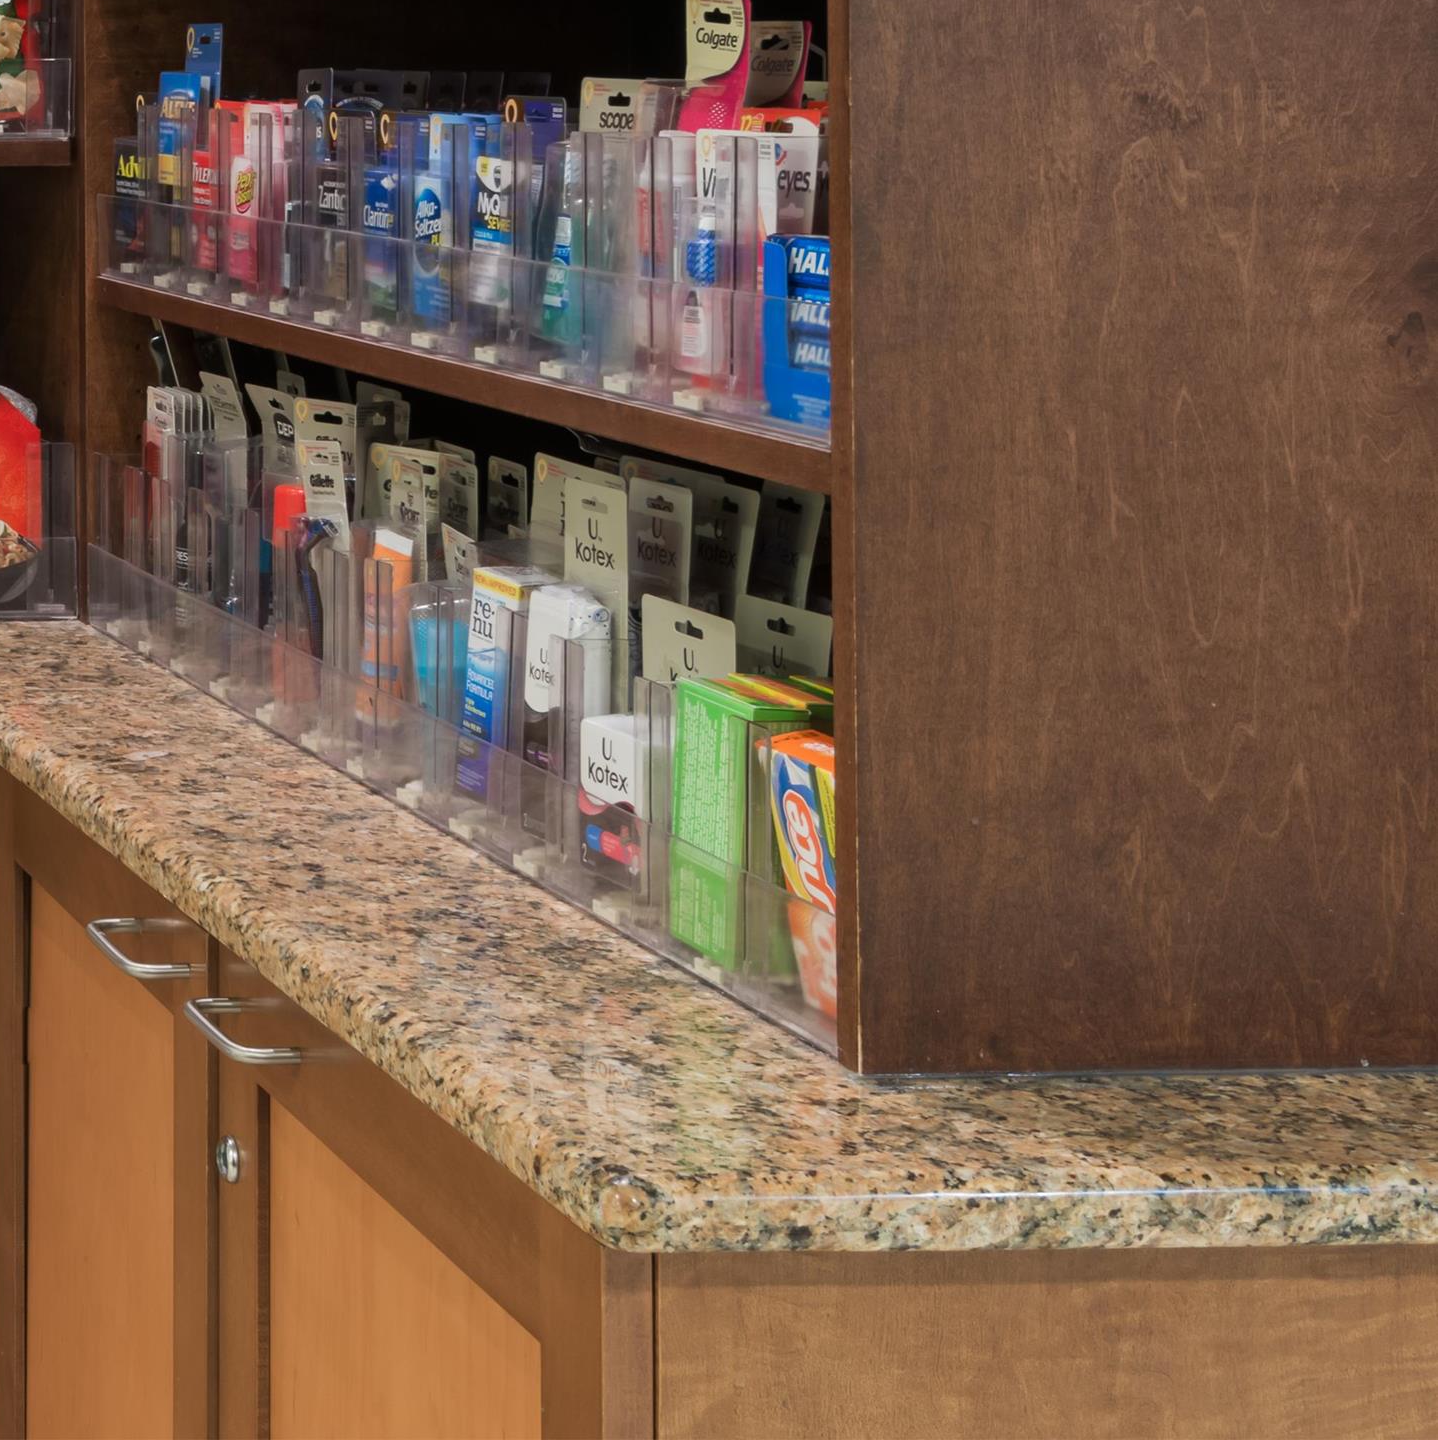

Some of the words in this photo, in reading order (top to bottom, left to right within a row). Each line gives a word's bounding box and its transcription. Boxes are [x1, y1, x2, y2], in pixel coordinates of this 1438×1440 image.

[695, 26, 739, 49] Colgate
[750, 53, 795, 75] Colgate
[599, 110, 635, 132] scope
[586, 516, 599, 541] U
[574, 537, 616, 570] kotex
[636, 538, 678, 568] kotex
[601, 735, 613, 761] U
[586, 755, 629, 794] kotex
